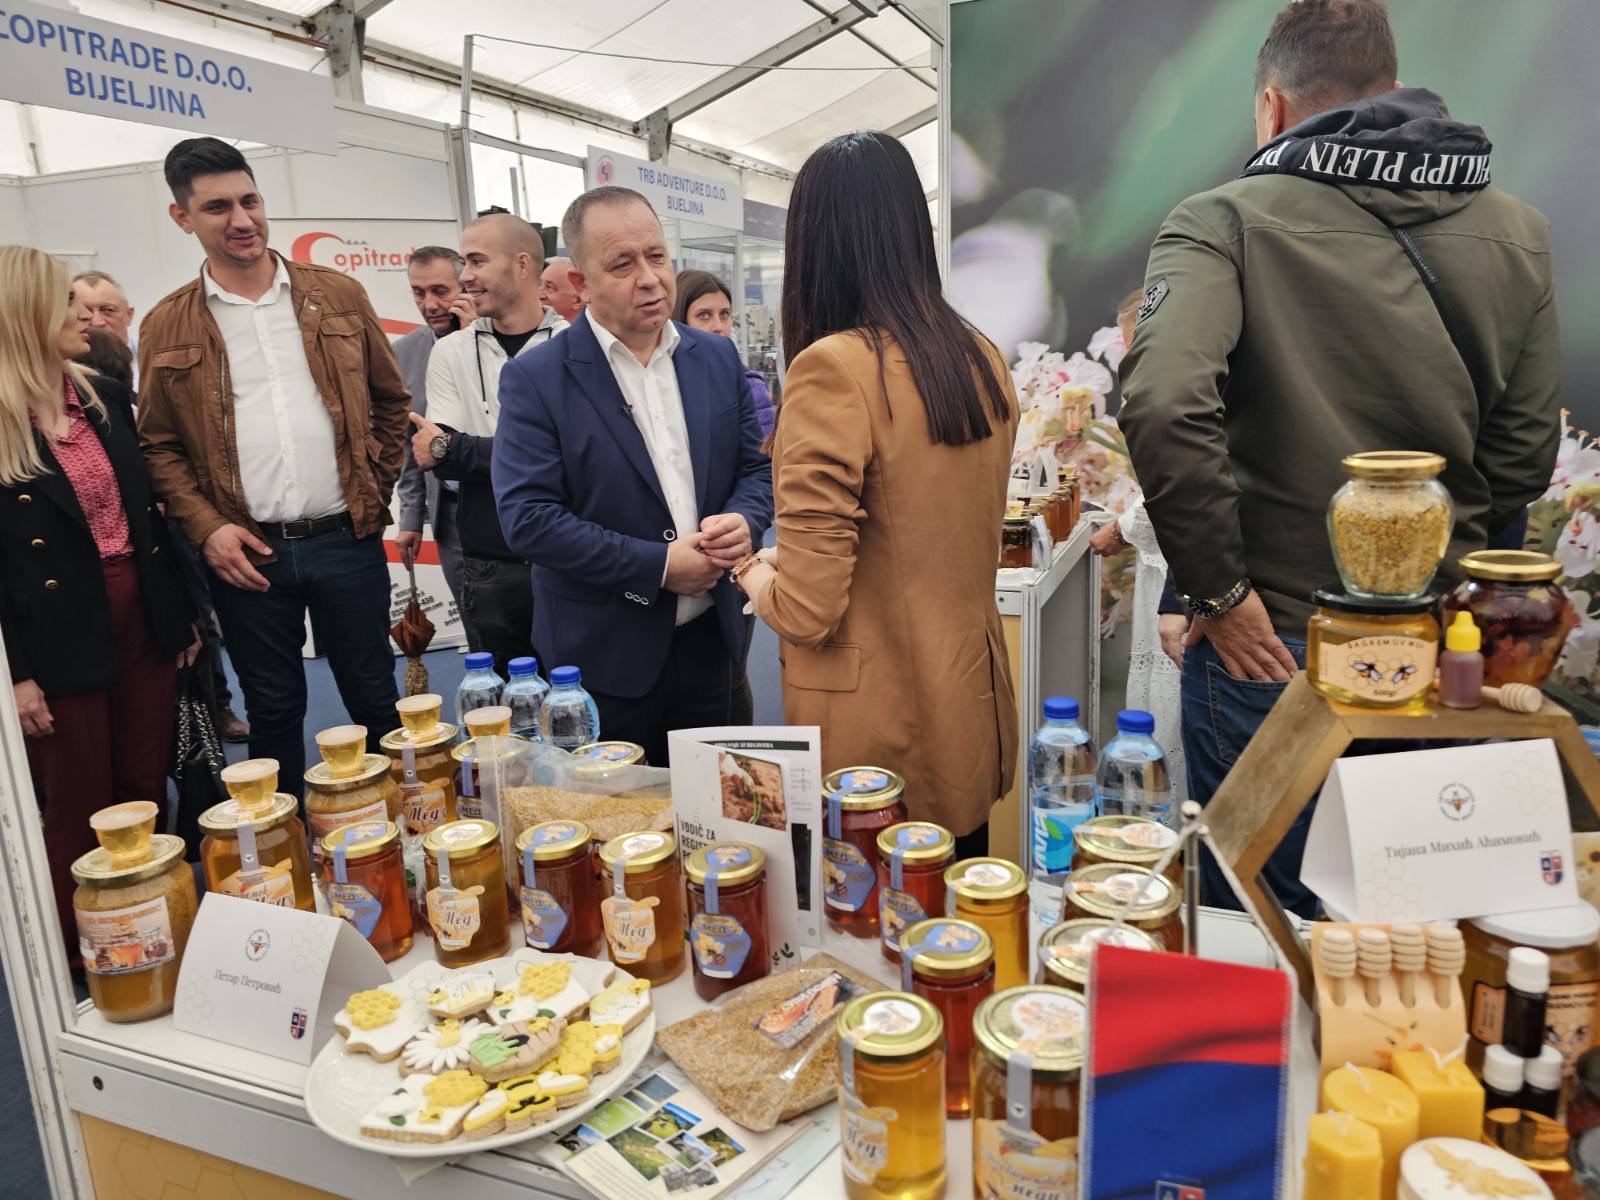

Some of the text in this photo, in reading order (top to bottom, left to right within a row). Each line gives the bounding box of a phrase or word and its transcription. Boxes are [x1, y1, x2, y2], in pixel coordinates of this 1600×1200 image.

[174, 52, 253, 93] D.O.O.
[65, 67, 206, 119] BIJELJINA
[1302, 142, 1407, 184] PLEIN
[1411, 153, 1490, 185] HILIPP
[637, 167, 728, 201] TRB ADVENTURE D.O.O.
[667, 196, 705, 216] BIJELJINA
[291, 231, 415, 273] Copitrad
[680, 820, 716, 841] VODIČ ZA
